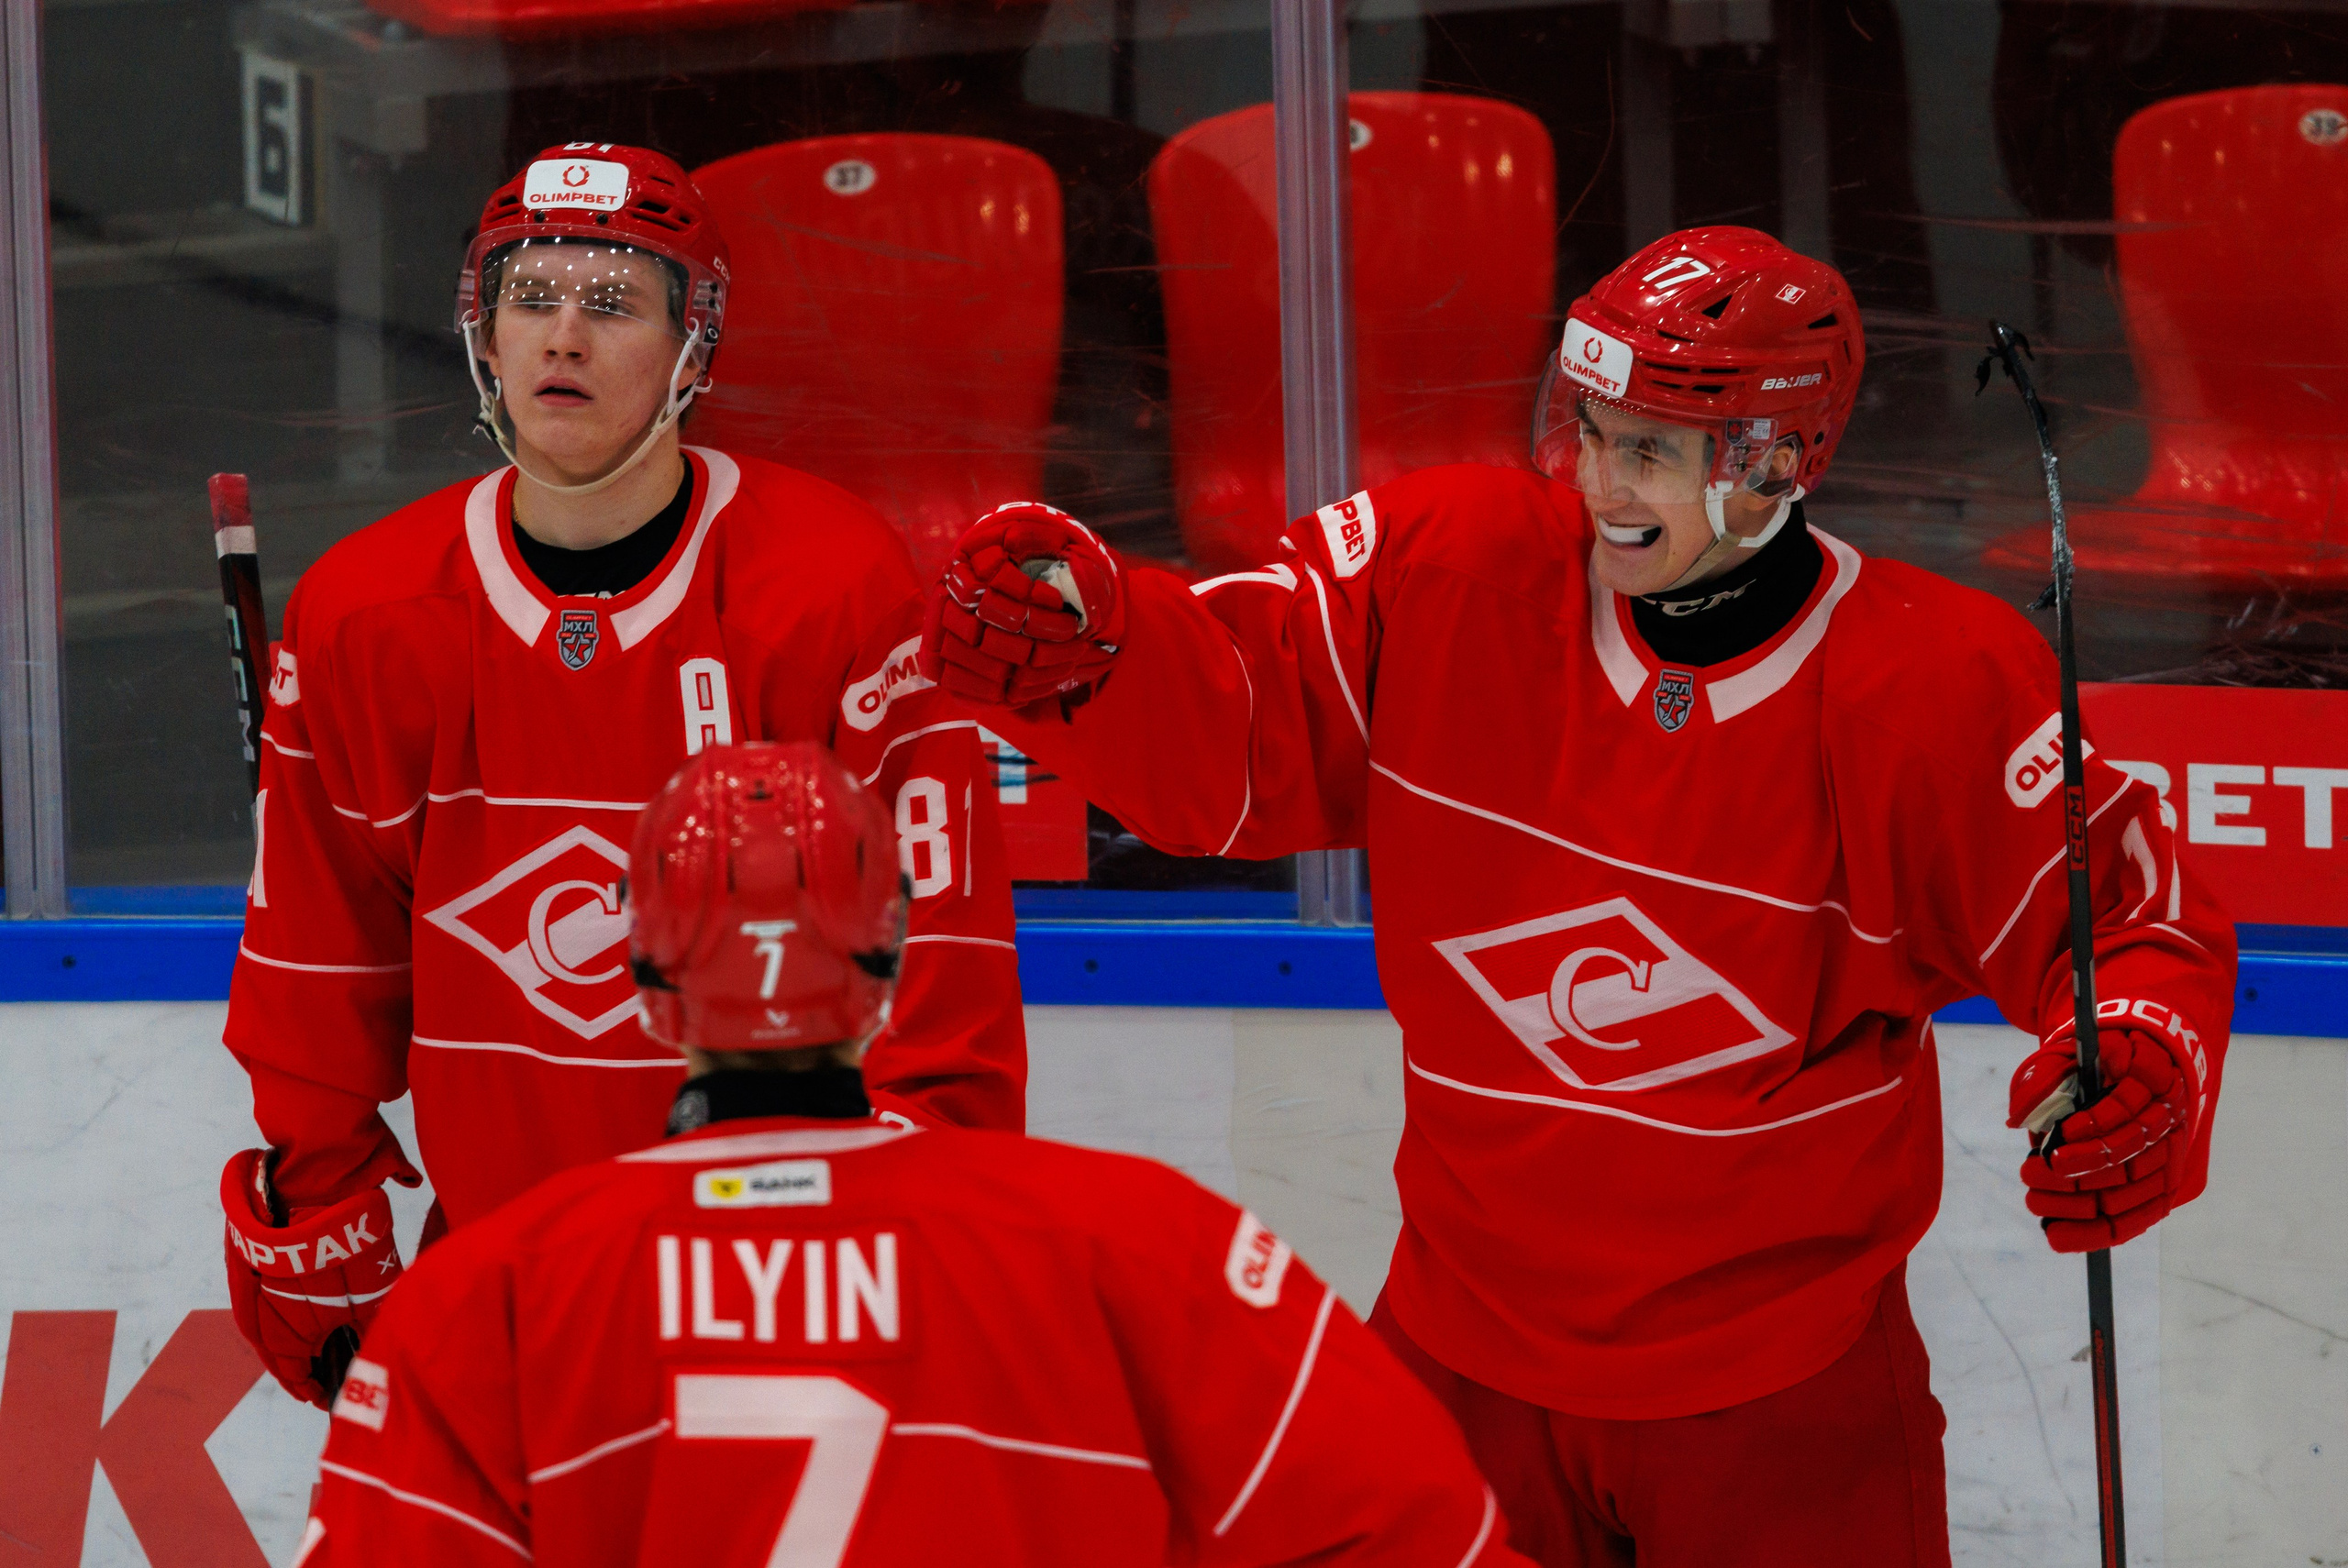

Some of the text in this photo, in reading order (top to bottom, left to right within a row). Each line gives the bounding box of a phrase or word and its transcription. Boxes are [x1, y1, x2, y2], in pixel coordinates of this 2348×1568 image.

[529, 191, 619, 206] OLIMPBET
[1642, 256, 1711, 291] 17
[1563, 356, 1621, 392] OLIMPBET
[1760, 372, 1822, 392] BAUER
[1639, 578, 1757, 617] CM
[564, 622, 593, 633] МХЛ
[858, 652, 921, 714] OLIM
[1661, 681, 1689, 695] МХЛ
[680, 657, 732, 756] A
[2068, 792, 2085, 865] CCM
[754, 940, 785, 1000] 7
[656, 1231, 901, 1344] ILYIN
[674, 1374, 892, 1568] 7
